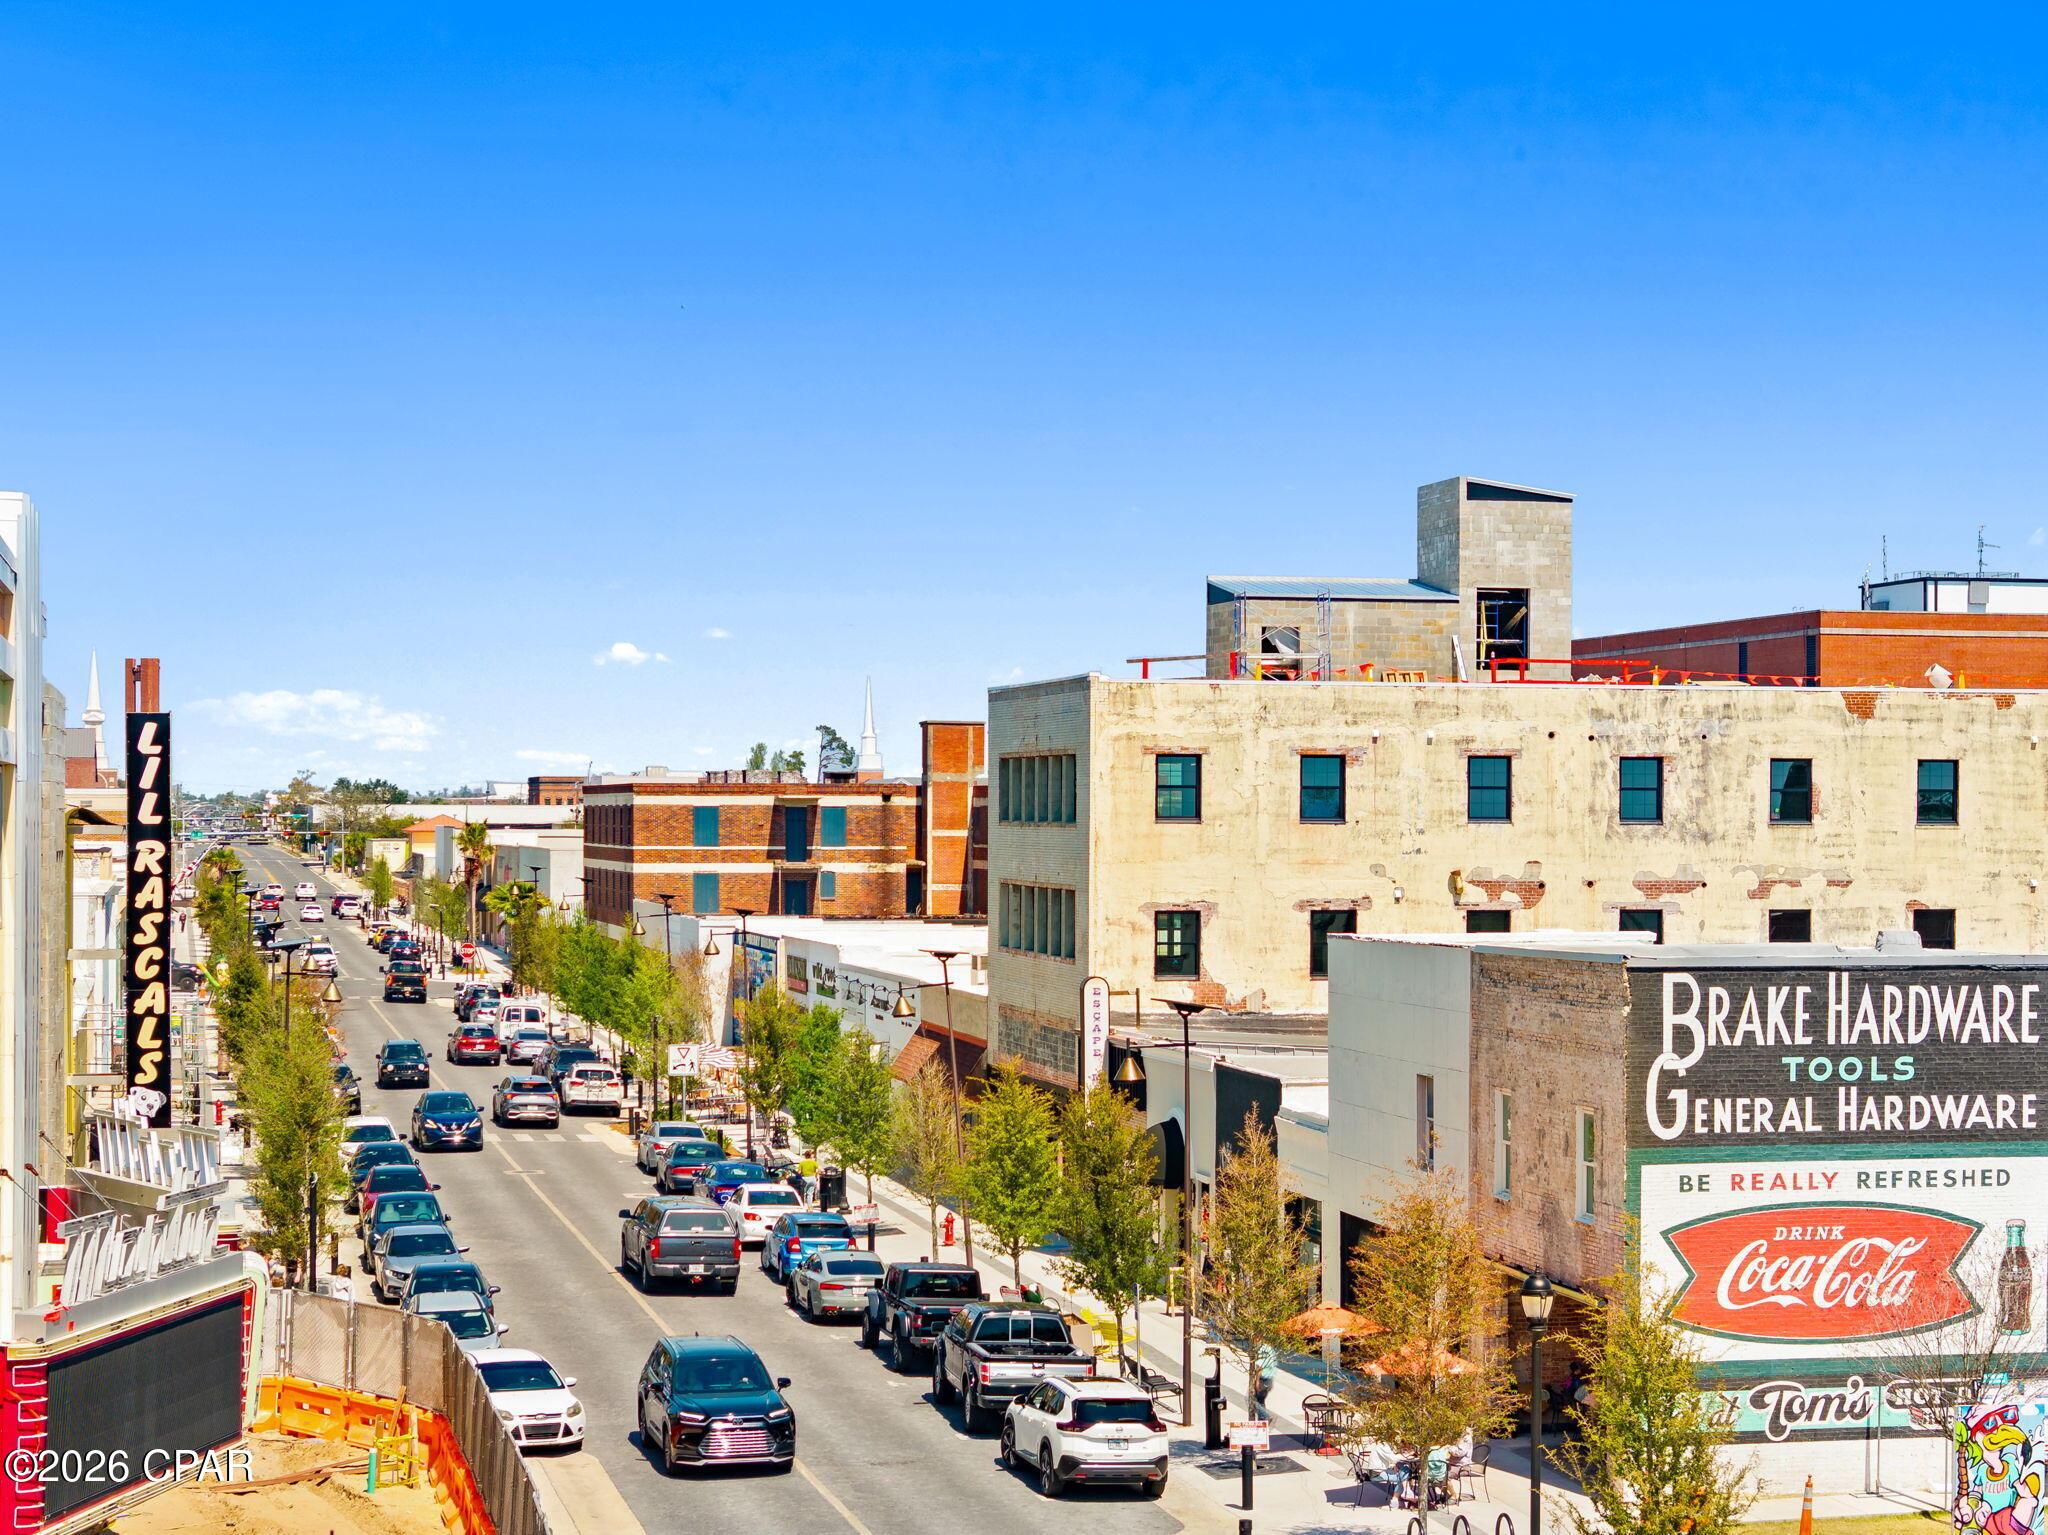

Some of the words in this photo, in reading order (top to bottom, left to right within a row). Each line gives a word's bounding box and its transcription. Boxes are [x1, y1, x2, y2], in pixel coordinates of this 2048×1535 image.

[137, 722, 163, 825] LIL
[133, 839, 166, 1085] RASCALS
[1092, 987, 1102, 1057] ESCAPE
[1662, 972, 1813, 1070] BRAKE
[1827, 971, 2040, 1045] HARDWARE
[1646, 1052, 1823, 1140] GENERAL
[1838, 1086, 2038, 1131] HARDWARE
[1782, 1056, 1916, 1082] TOOLS
[1679, 1174, 1710, 1193] BE
[1730, 1171, 1839, 1191] REALLY
[1857, 1169, 2011, 1190] REFRESHED
[1773, 1225, 1846, 1241] DRINK
[1749, 1377, 1874, 1440] Tom's
